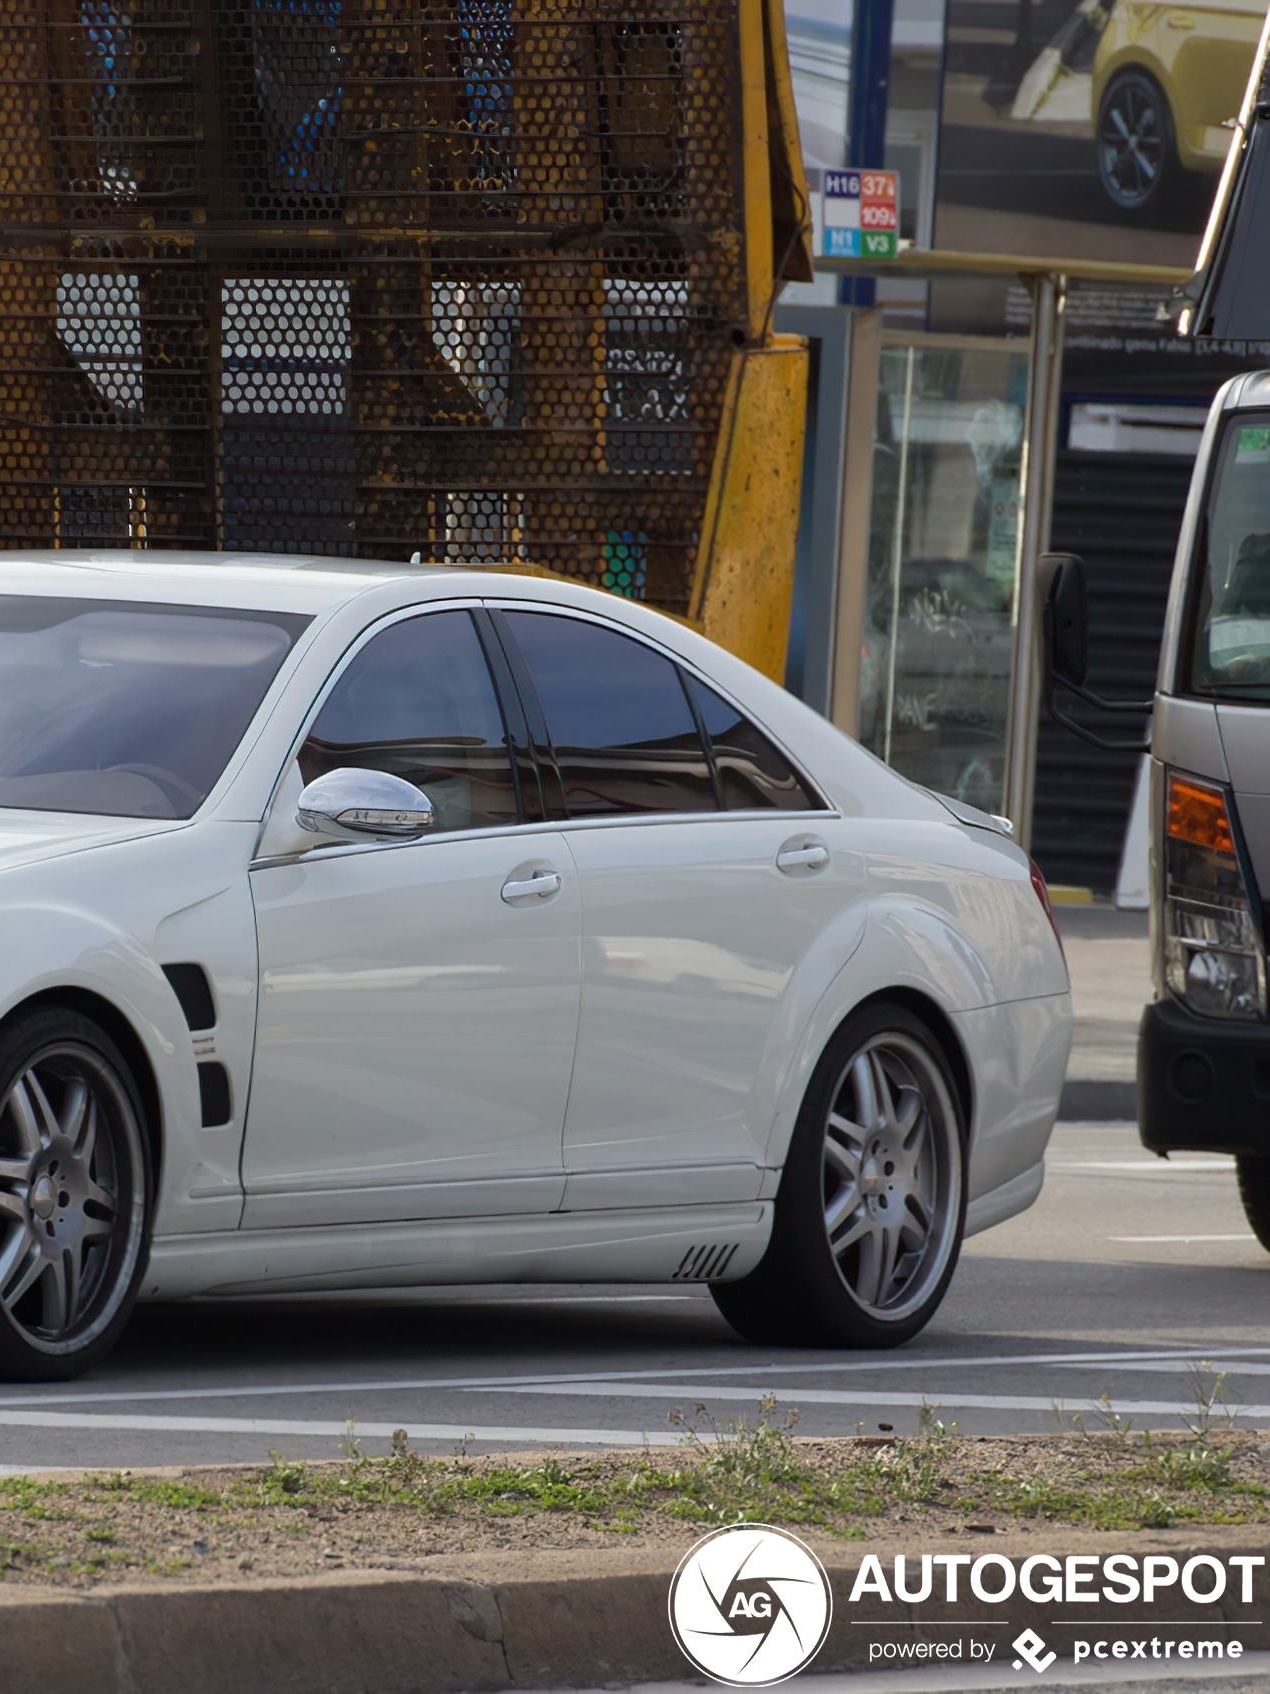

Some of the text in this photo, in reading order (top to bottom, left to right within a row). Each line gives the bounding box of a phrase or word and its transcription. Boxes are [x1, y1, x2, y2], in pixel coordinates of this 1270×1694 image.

[826, 175, 860, 194] H16
[862, 176, 886, 195] 37
[863, 207, 890, 225] 109
[866, 235, 889, 252] V3
